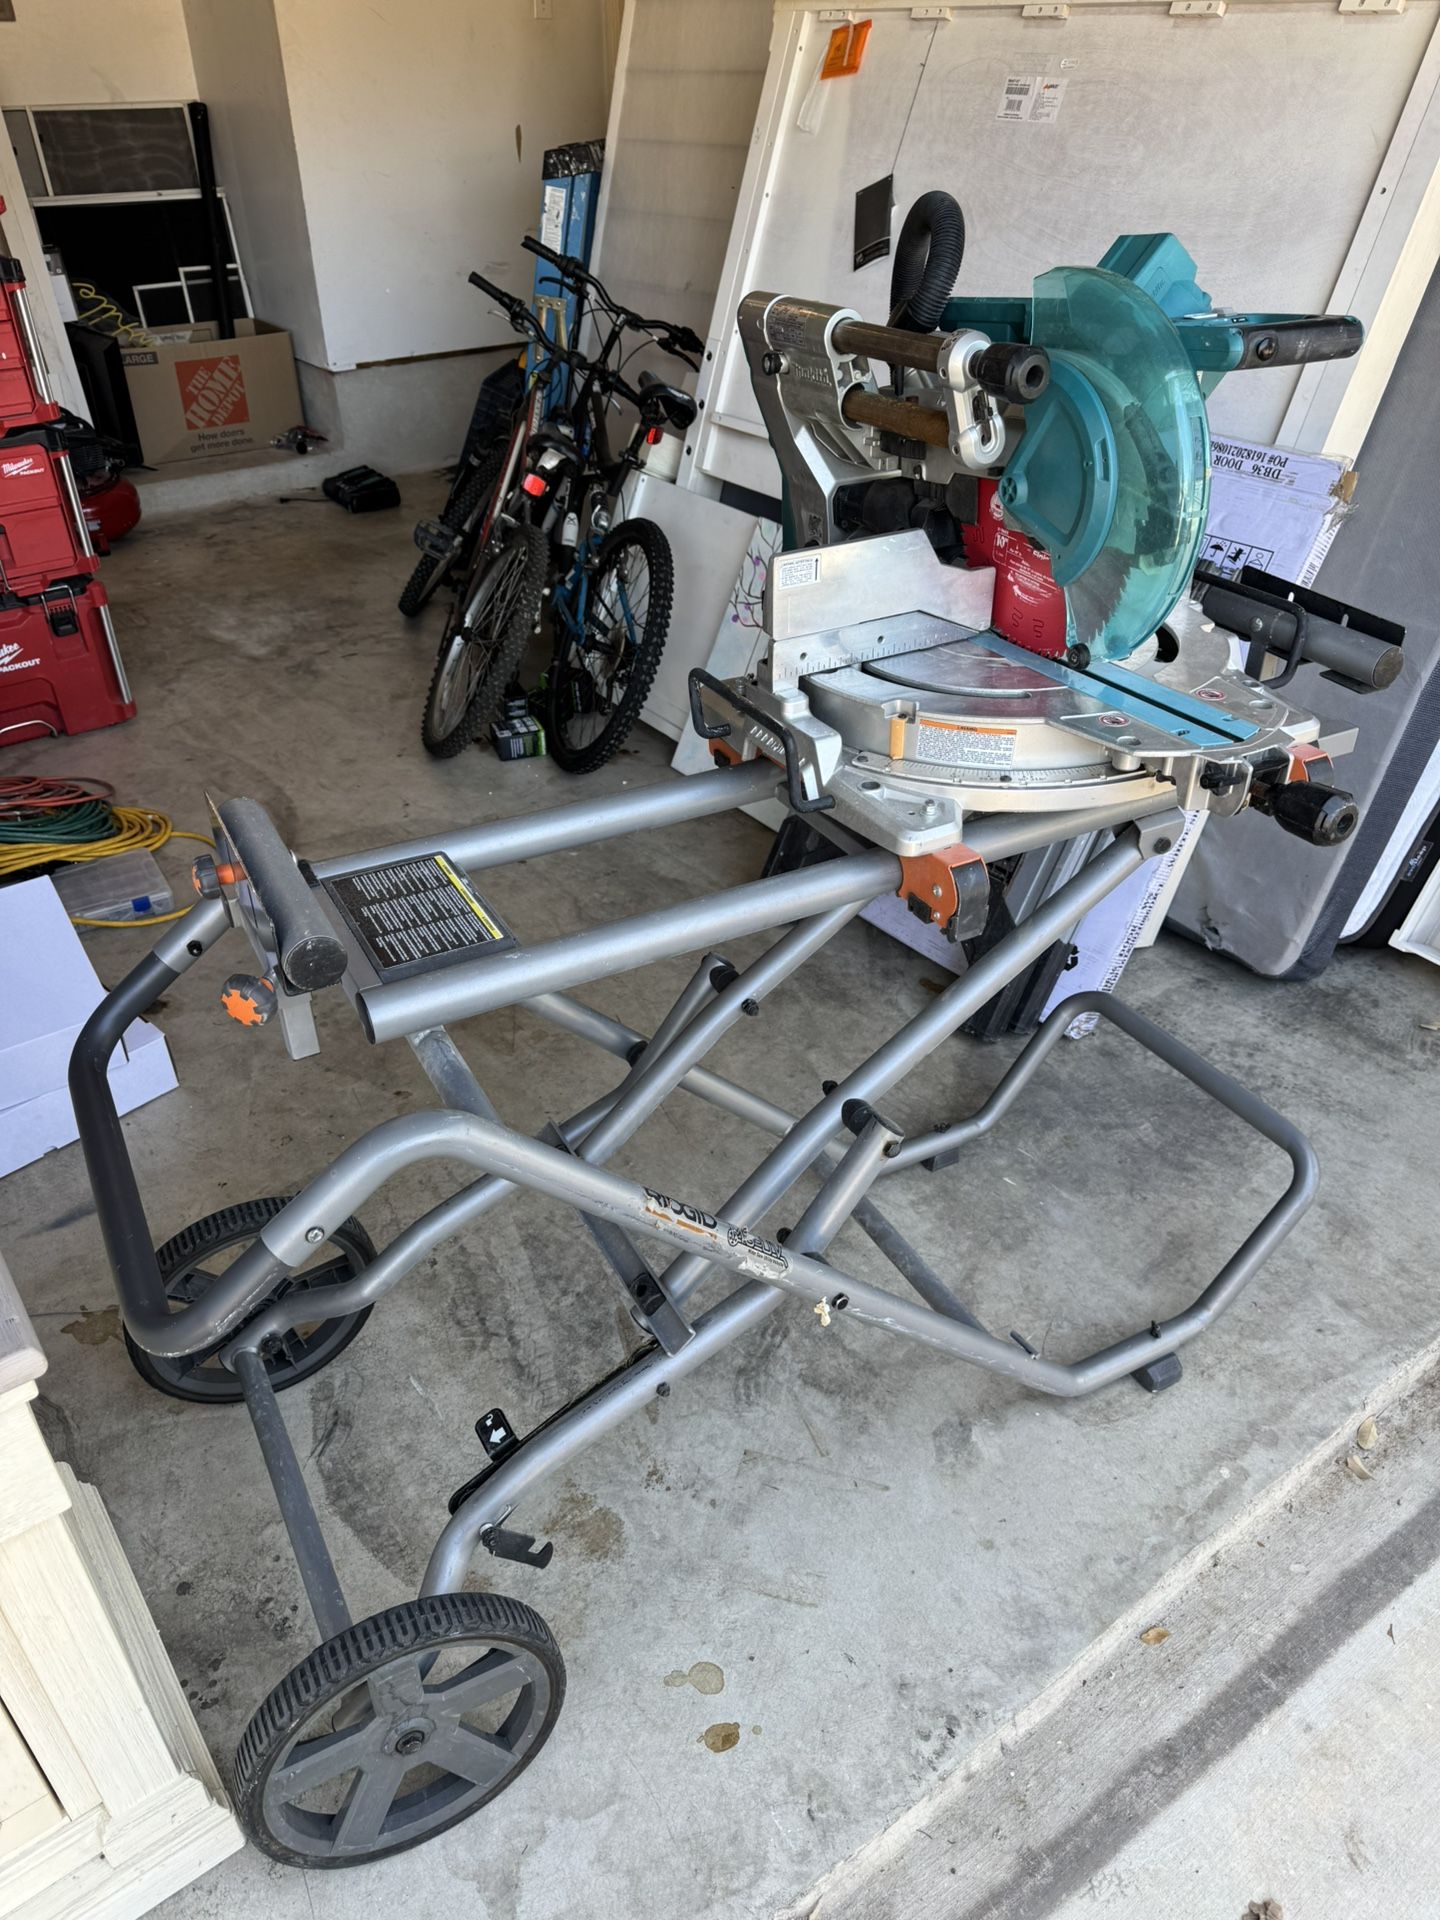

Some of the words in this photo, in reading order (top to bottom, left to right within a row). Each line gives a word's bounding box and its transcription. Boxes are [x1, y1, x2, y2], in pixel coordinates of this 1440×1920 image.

[186, 365, 211, 395] THE
[185, 355, 240, 429] HOME
[211, 380, 245, 427] DEPOT
[197, 432, 218, 442] How
[219, 428, 245, 438] doers
[190, 442, 206, 453] get
[207, 440, 230, 449] more
[1213, 454, 1244, 471] DOOR
[1267, 452, 1289, 468] PO#
[1252, 462, 1282, 480] DB36
